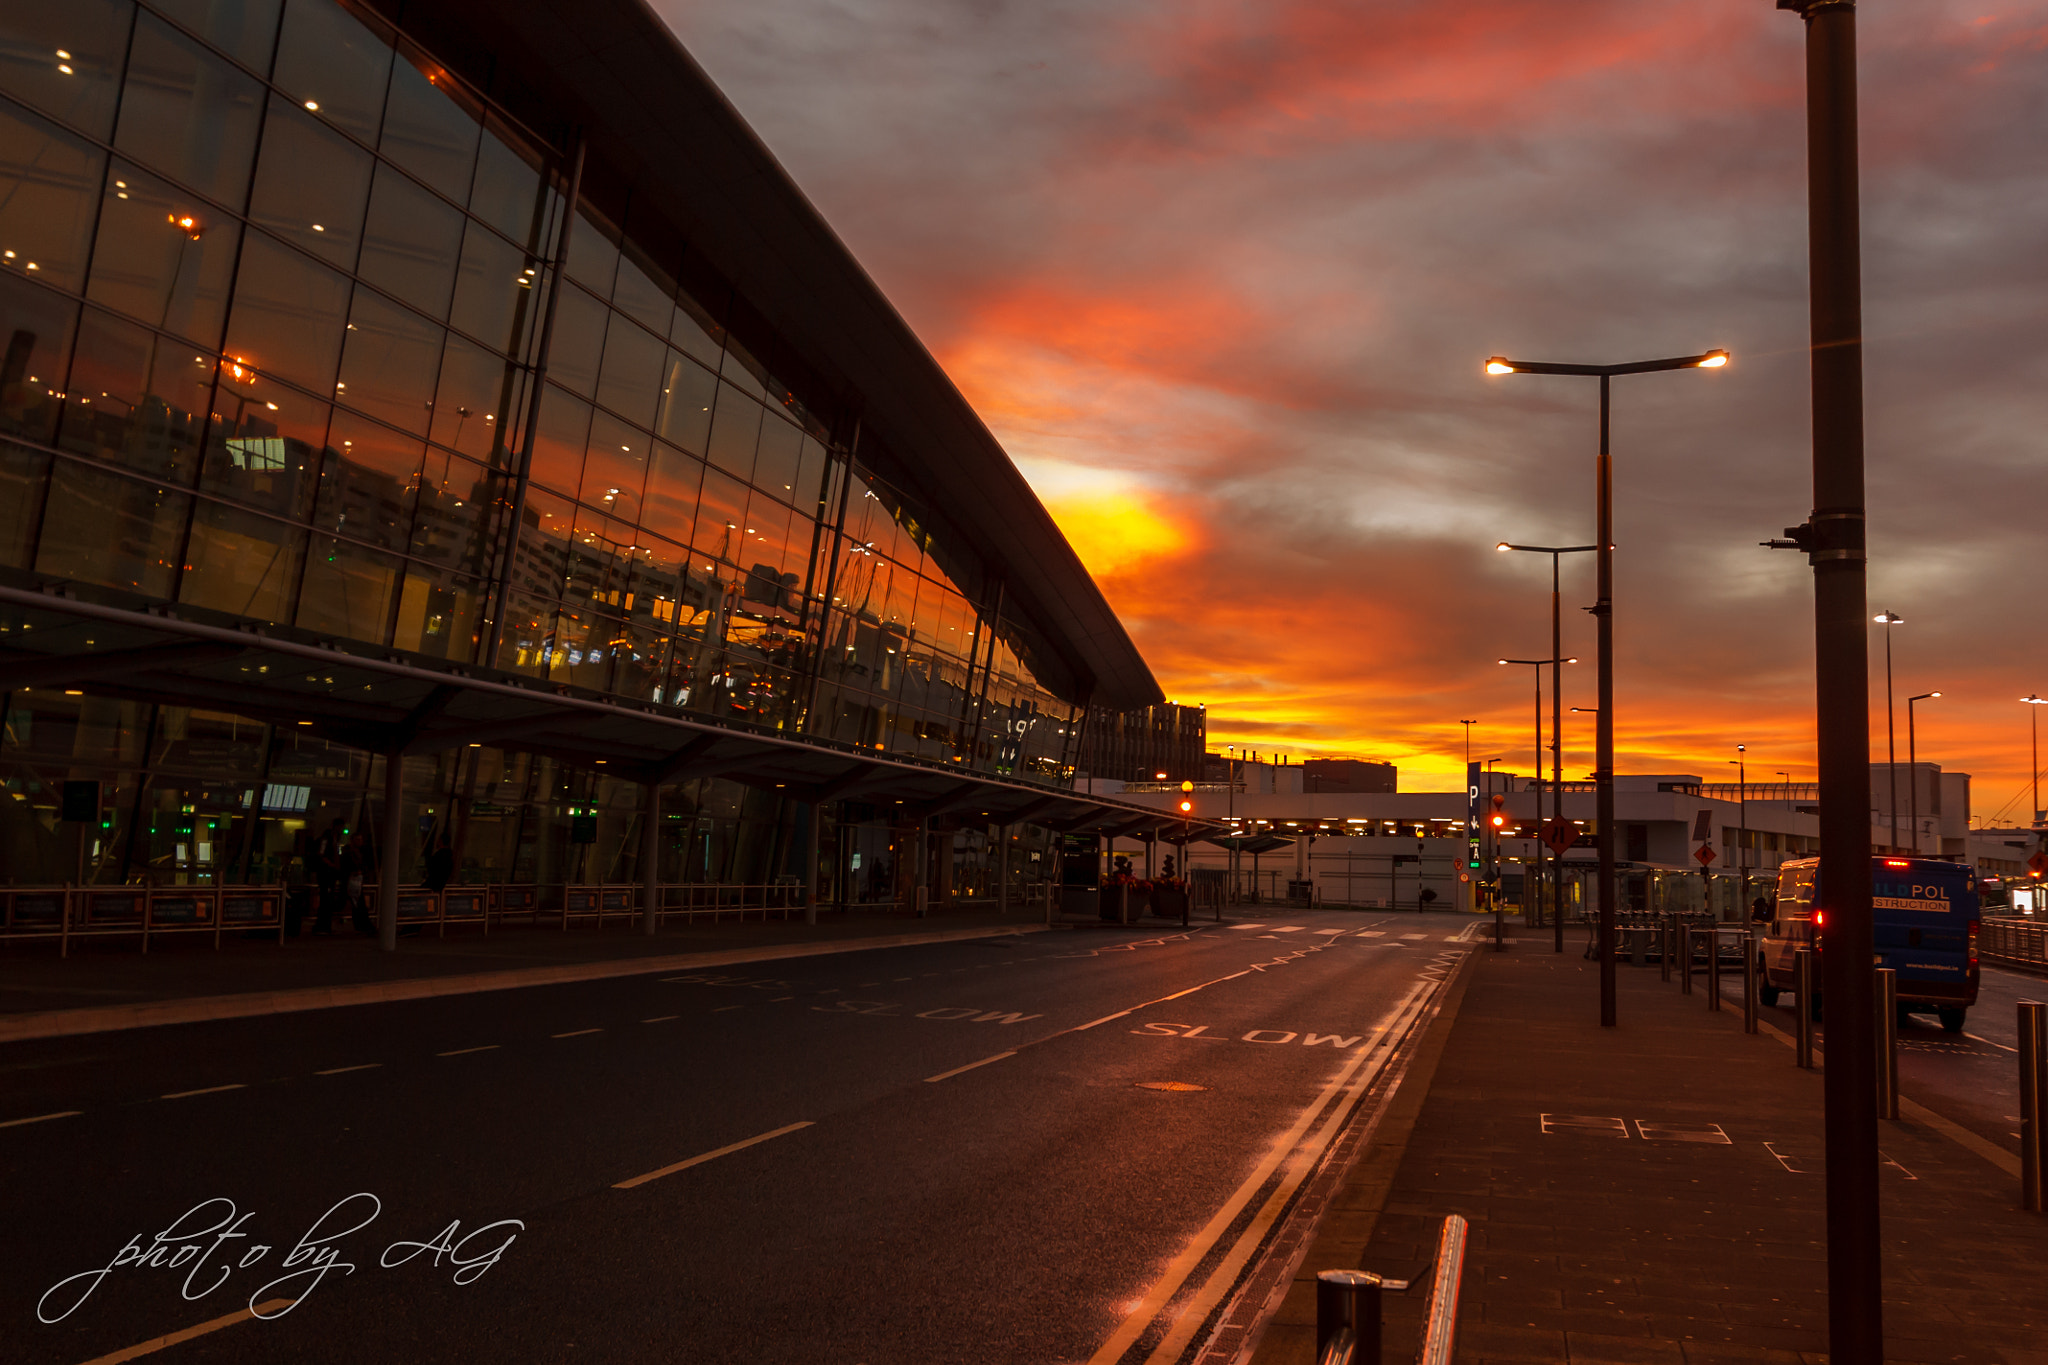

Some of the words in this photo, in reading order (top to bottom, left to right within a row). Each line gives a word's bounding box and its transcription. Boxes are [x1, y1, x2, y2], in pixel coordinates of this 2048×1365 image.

[1469, 785, 1479, 807] P
[1875, 883, 1950, 900] ILDPOL
[1874, 898, 1947, 910] STRUCTION
[810, 1000, 1044, 1024] SLOW
[1129, 1022, 1363, 1048] SLOW
